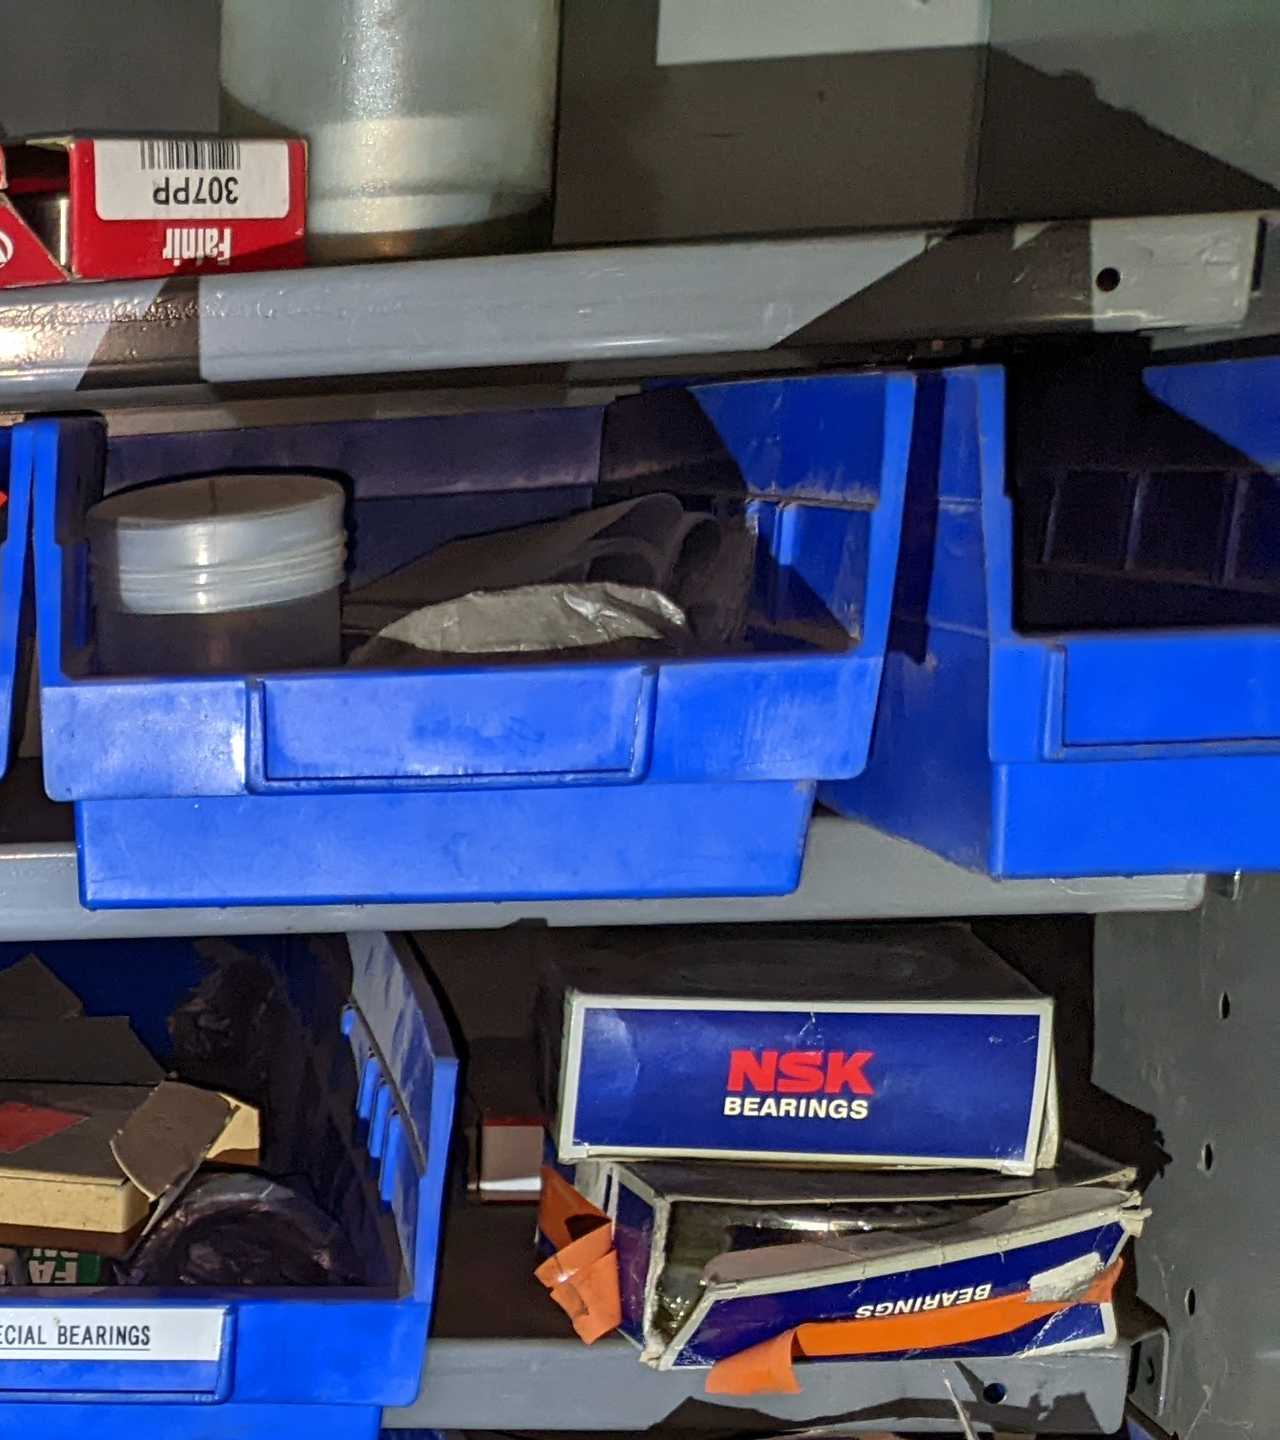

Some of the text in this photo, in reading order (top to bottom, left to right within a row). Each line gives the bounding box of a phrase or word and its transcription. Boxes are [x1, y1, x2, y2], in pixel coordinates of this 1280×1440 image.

[153, 175, 239, 203] 307PP
[162, 225, 232, 265] Fafnir
[727, 1049, 875, 1096] NSK
[724, 1096, 869, 1121] BEARINGS
[855, 1282, 992, 1321] BEARINGS
[56, 1324, 151, 1347] BEARINGS
